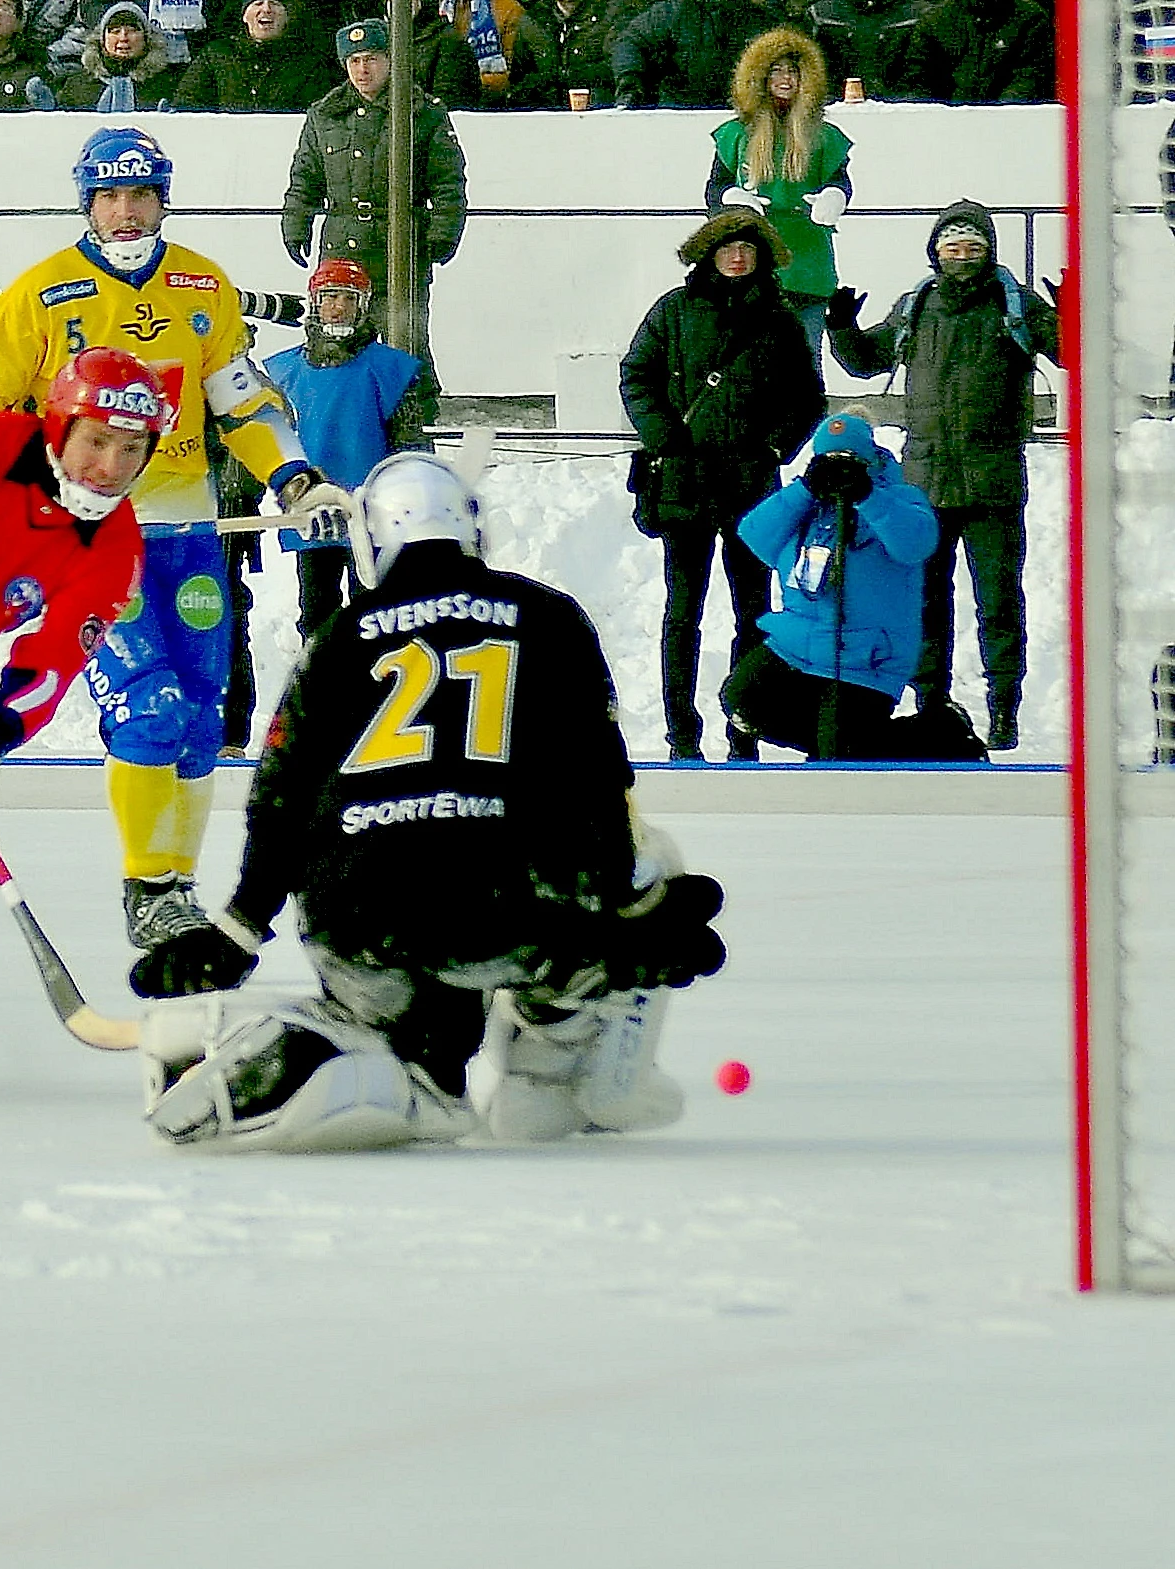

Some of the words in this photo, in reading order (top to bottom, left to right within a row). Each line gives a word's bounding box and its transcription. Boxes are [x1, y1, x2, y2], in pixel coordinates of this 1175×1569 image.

[66, 317, 86, 354] 5
[359, 593, 518, 640] SVENSSON
[339, 637, 519, 774] 21
[341, 792, 505, 835] SPORTEWA
